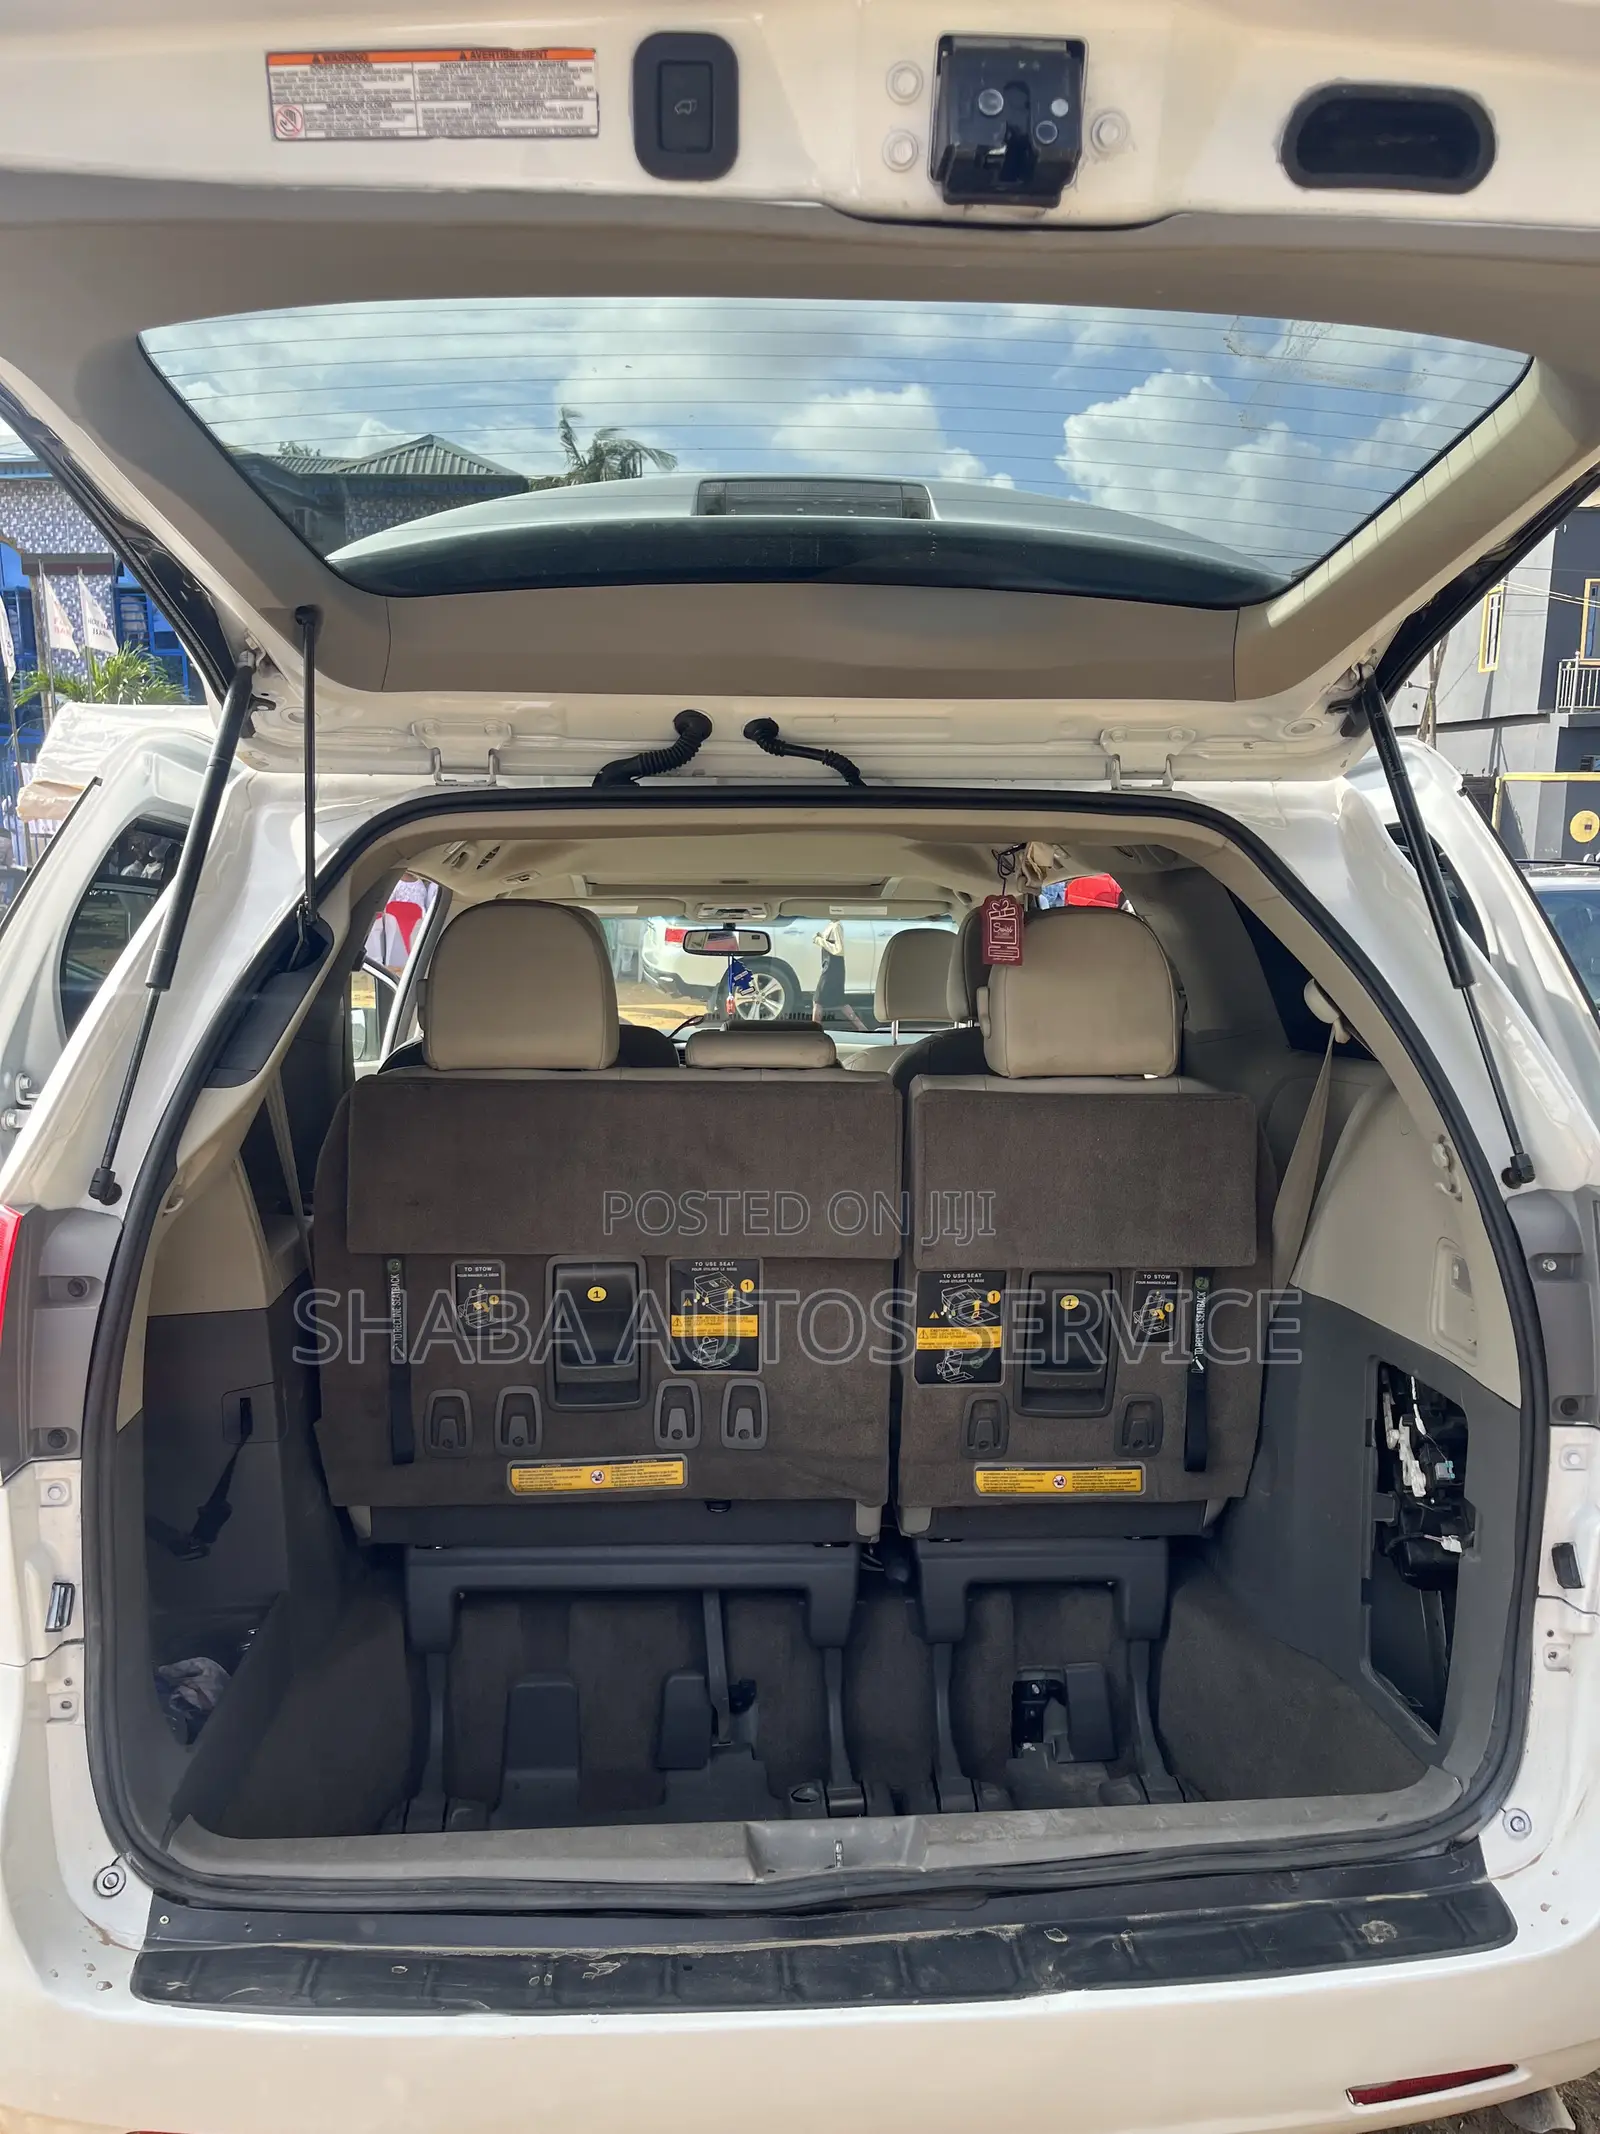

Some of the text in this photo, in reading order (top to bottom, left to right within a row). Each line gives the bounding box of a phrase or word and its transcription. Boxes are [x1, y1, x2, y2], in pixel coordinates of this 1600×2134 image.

[390, 1274, 402, 1306] SEATBACK
[392, 1306, 403, 1332] RECLINE
[1194, 1291, 1206, 1355] TO RECLINE SEATBACK
